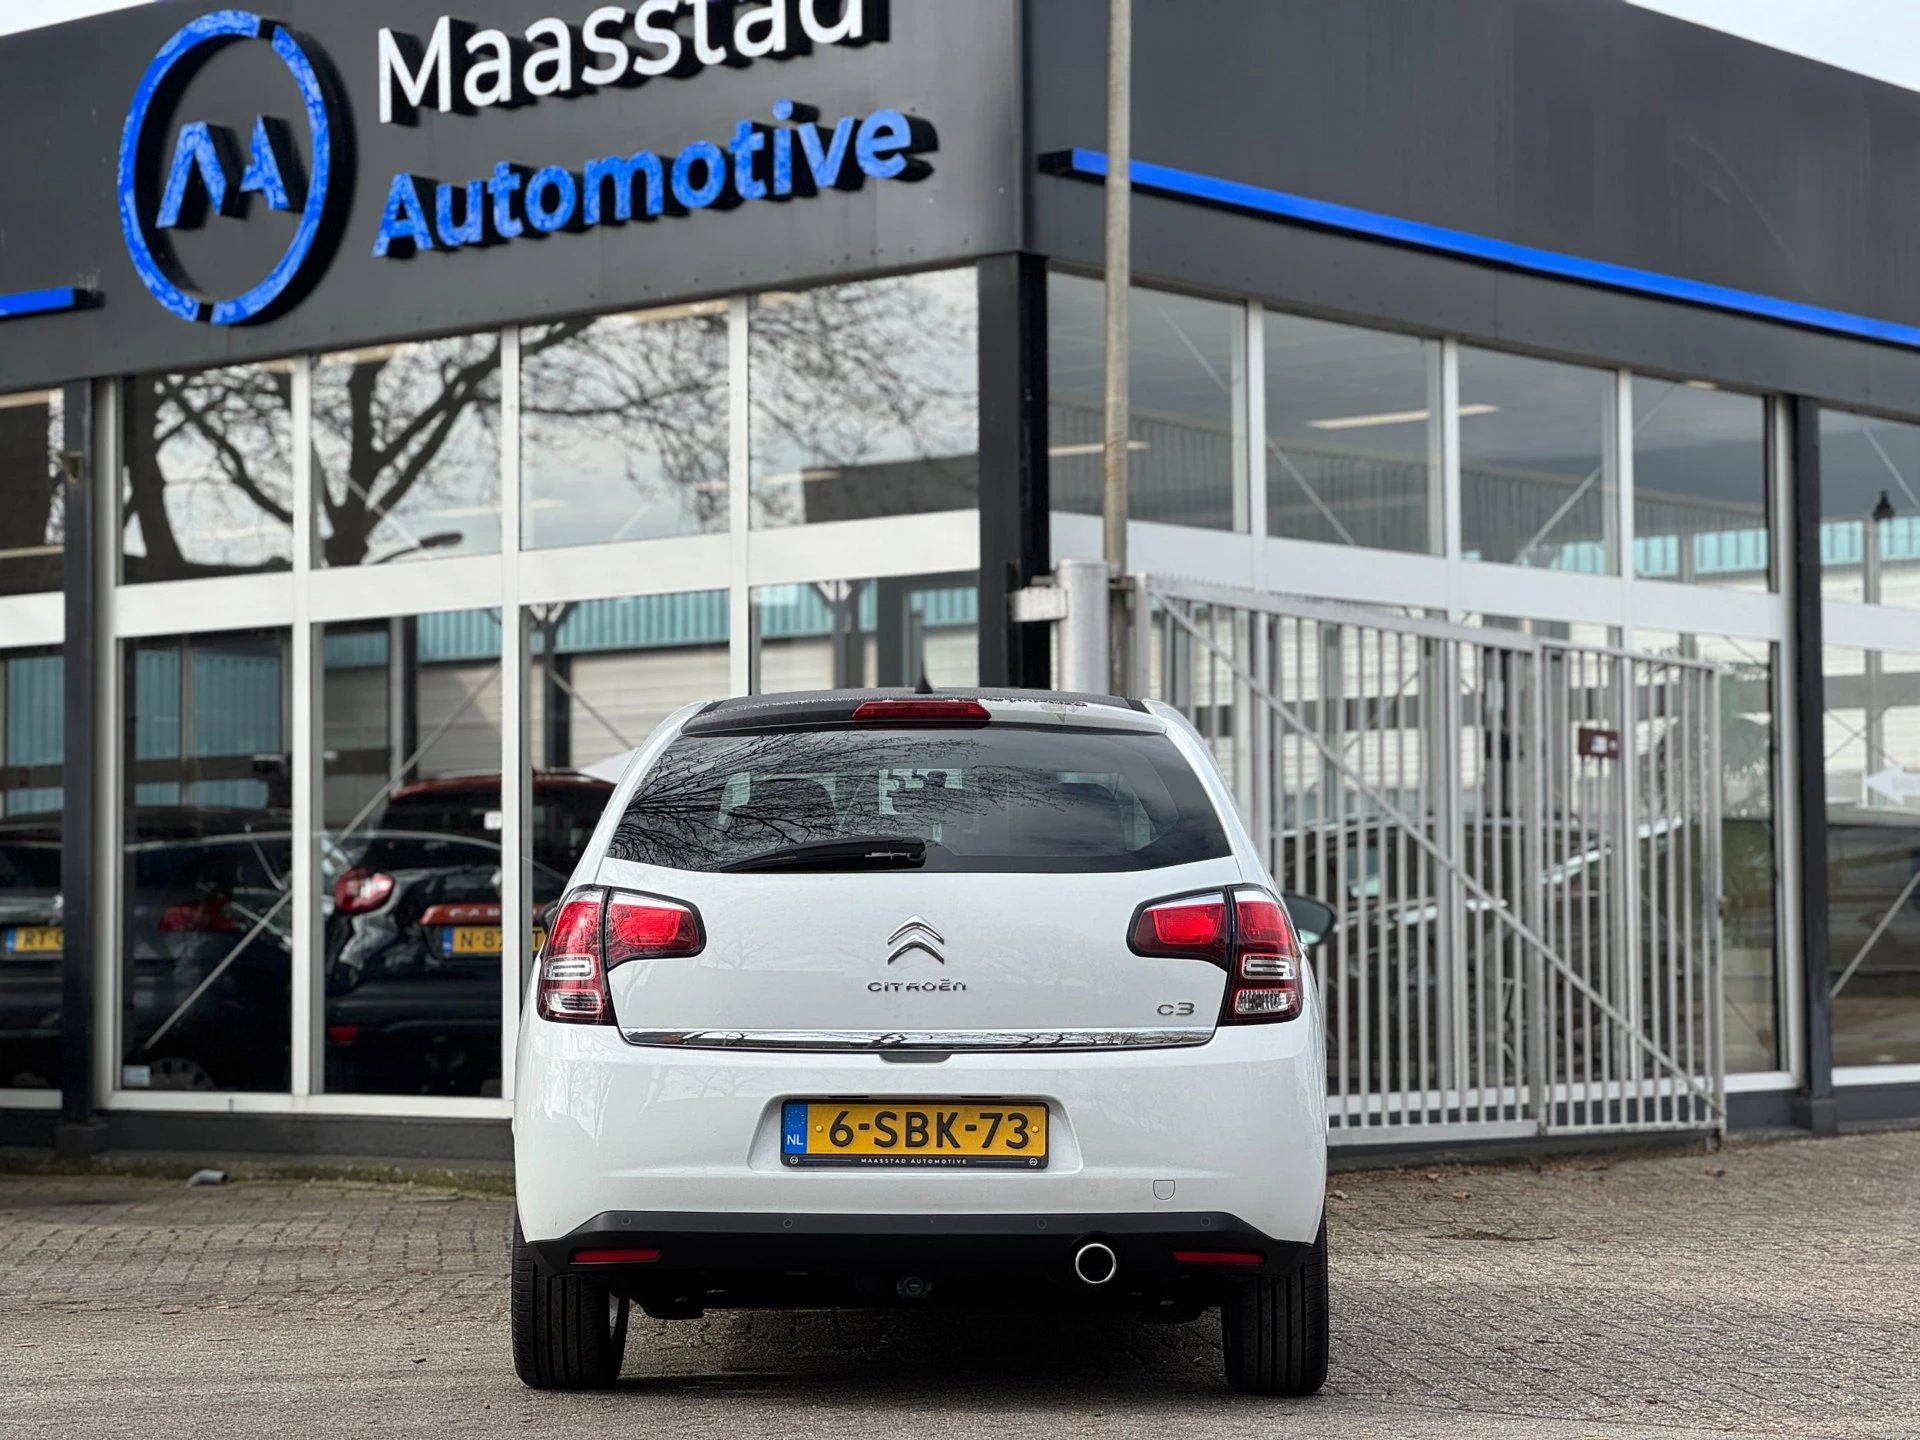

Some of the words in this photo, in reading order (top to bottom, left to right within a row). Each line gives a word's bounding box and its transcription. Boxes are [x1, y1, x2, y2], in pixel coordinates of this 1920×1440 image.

[372, 97, 912, 257] Automotive
[1156, 1002, 1195, 1017] C3
[828, 1110, 1030, 1149] 6-SBK-73
[786, 1133, 804, 1146] NL
[860, 1157, 907, 1165] MAASSTAD
[910, 1158, 967, 1166] AUTOMOTIVE
